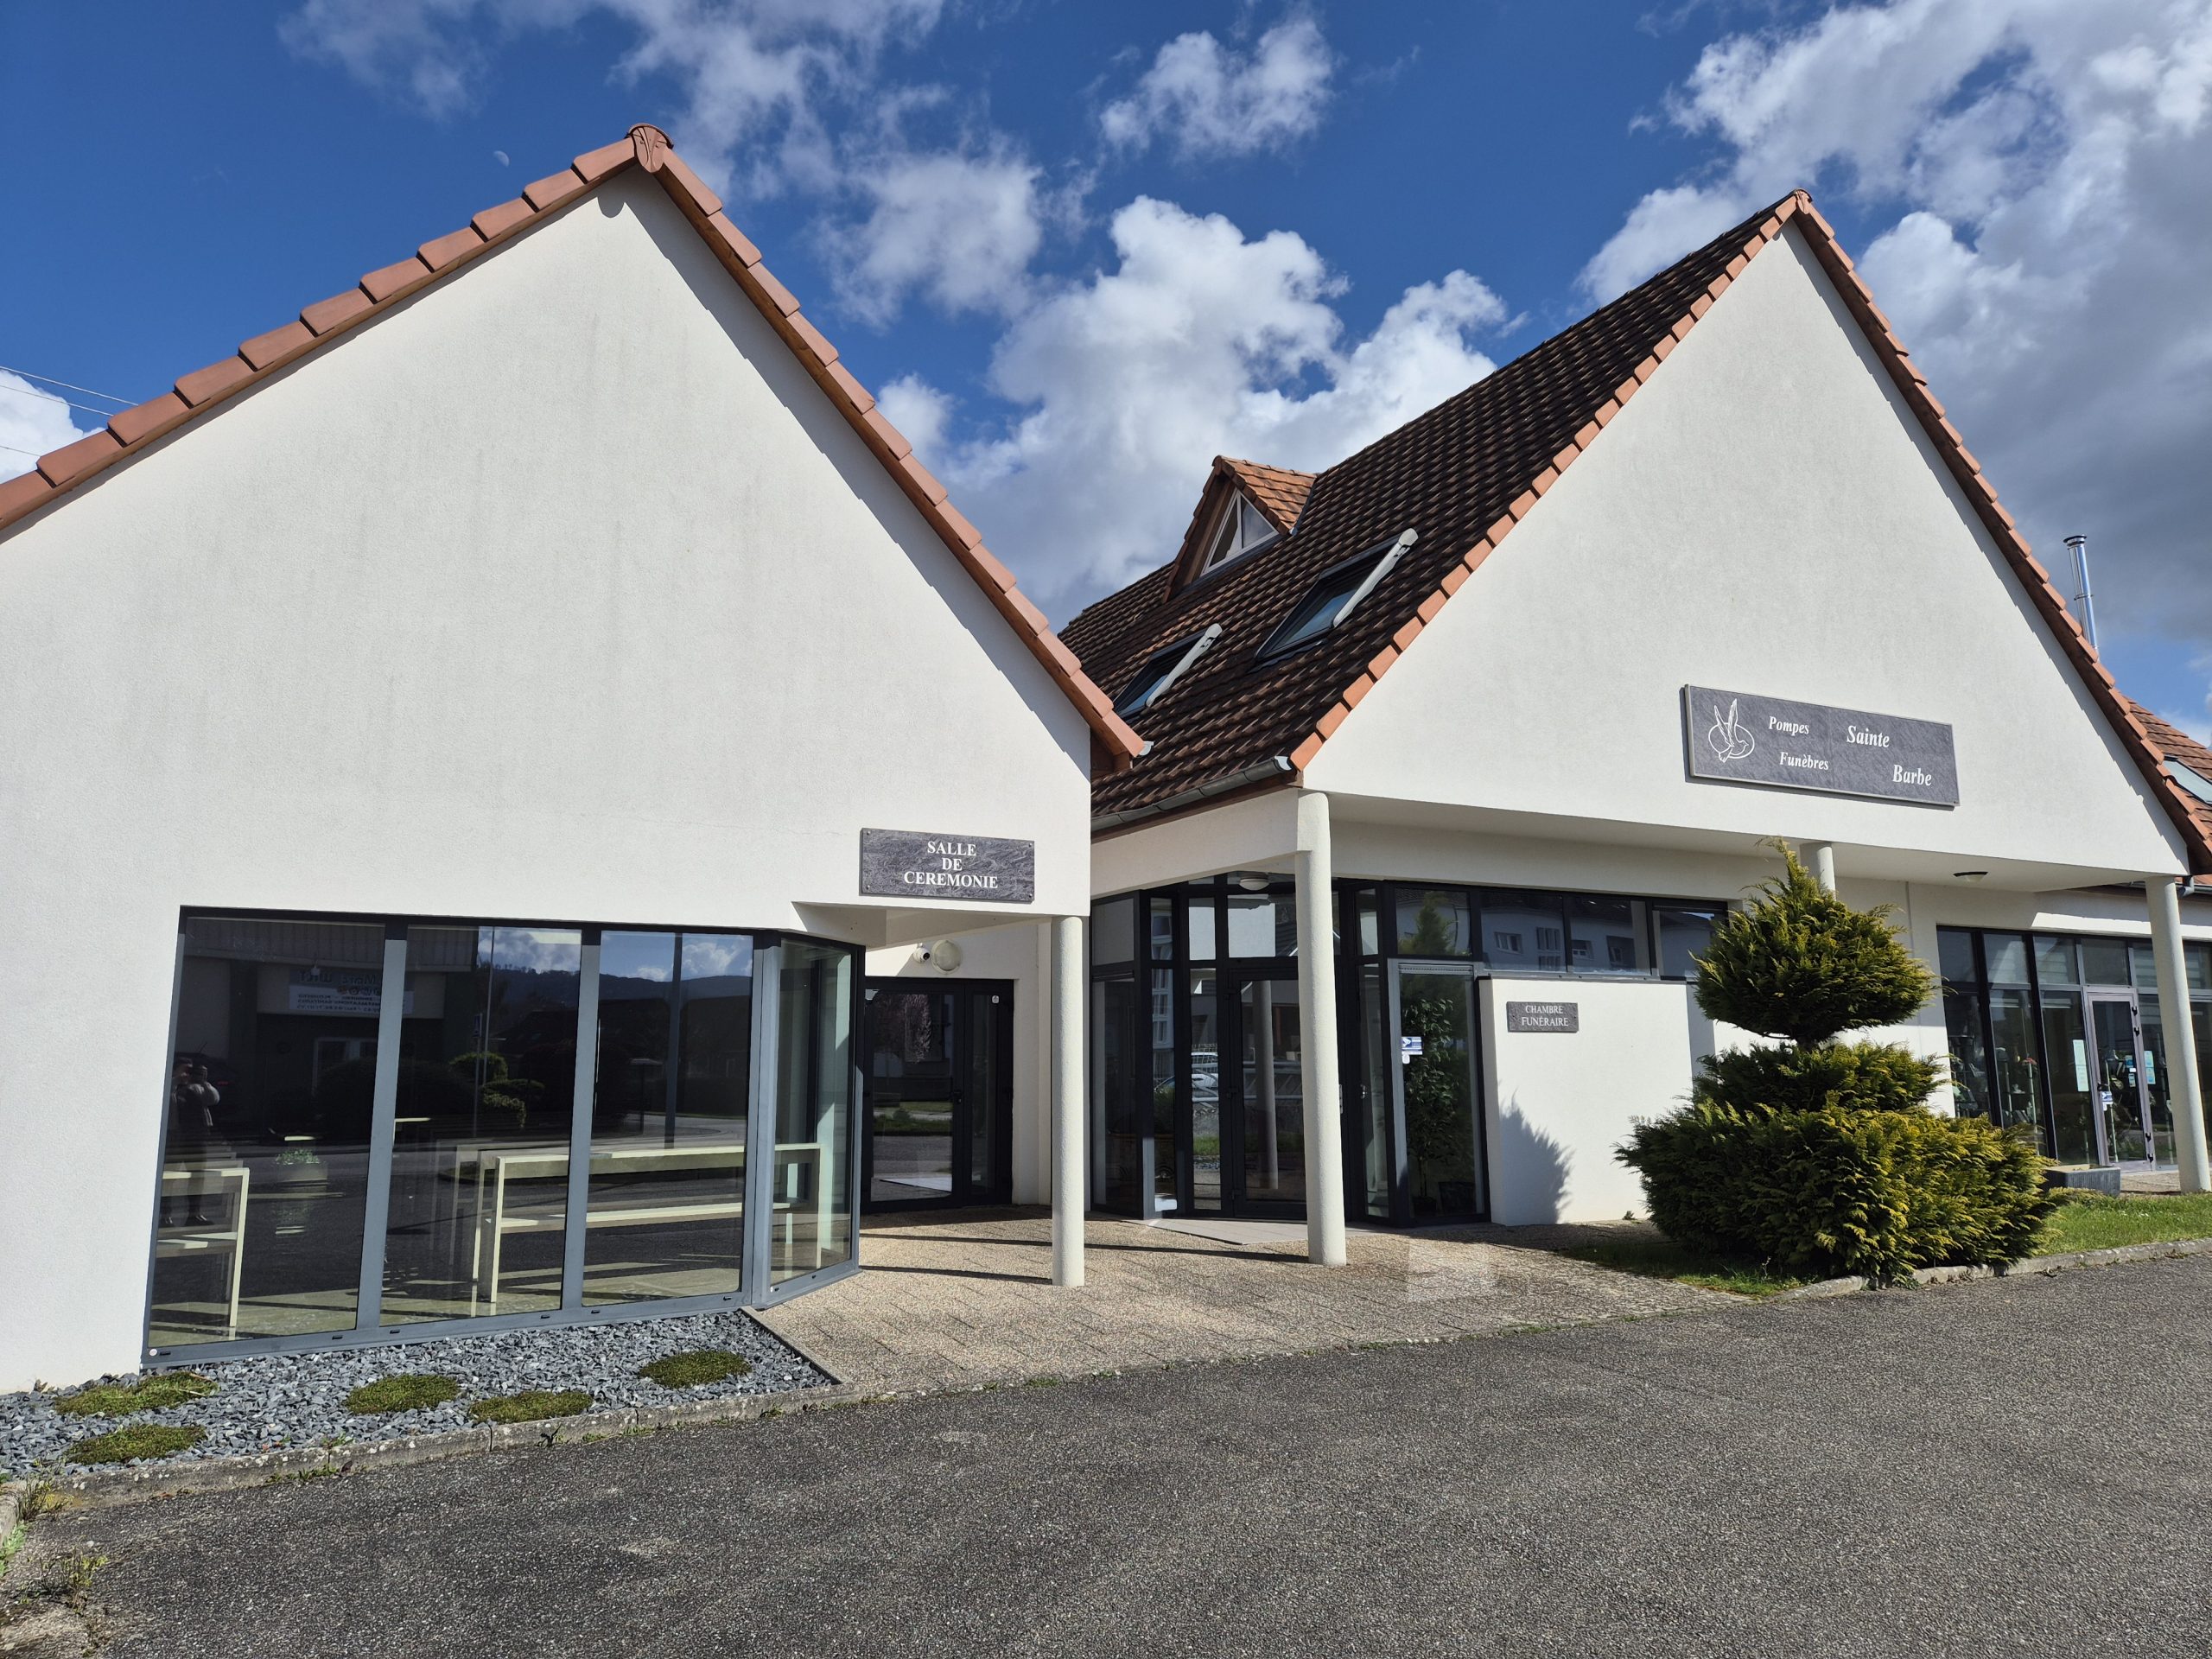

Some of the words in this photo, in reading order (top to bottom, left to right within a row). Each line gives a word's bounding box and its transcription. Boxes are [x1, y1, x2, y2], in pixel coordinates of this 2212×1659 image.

[1769, 716, 1809, 736] Pompes
[1847, 725, 1890, 748] Sainte
[1779, 752, 1829, 771] Funèbres
[1892, 764, 1932, 786] Barbe
[927, 841, 976, 856] SALLE
[942, 857, 963, 872] DE
[904, 871, 998, 889] CEREMONIE
[1525, 1005, 1564, 1014] CHAMBRE
[1522, 1016, 1568, 1027] FUNÉRAIRE
